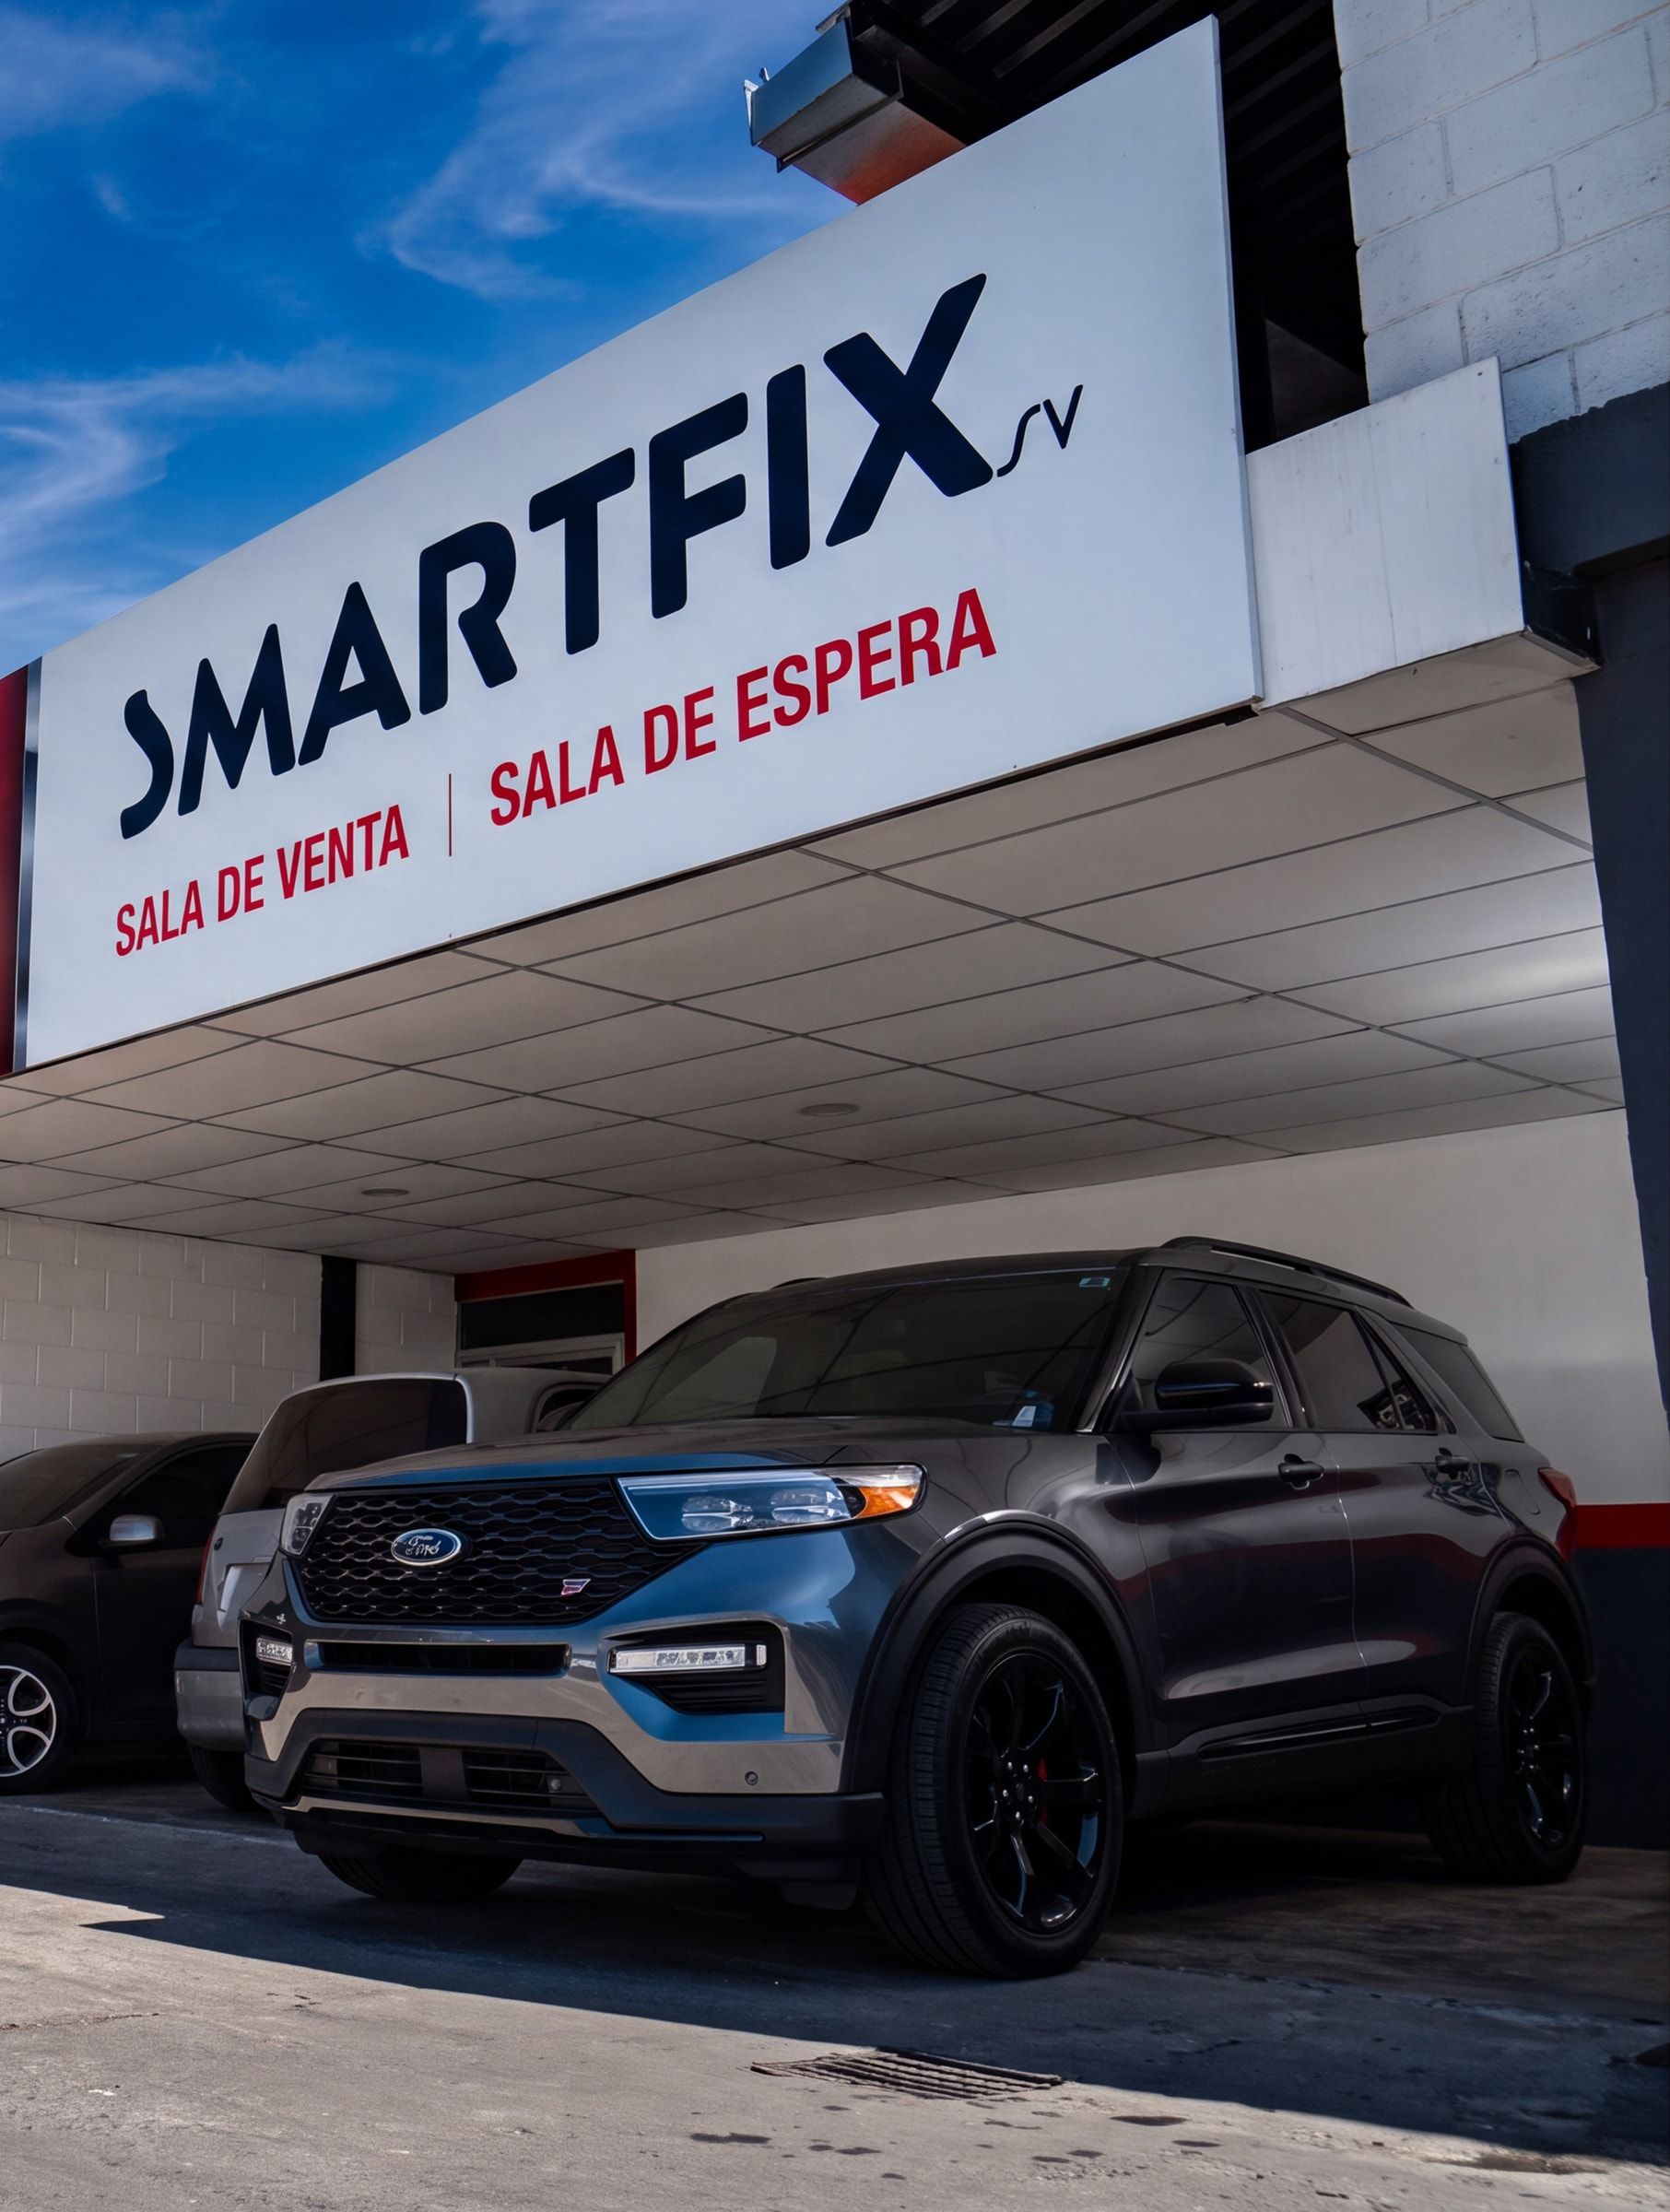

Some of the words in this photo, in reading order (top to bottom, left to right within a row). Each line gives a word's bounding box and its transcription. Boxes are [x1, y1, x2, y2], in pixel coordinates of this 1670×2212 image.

[120, 273, 994, 839] SMARTFIX
[489, 724, 626, 827] SALA
[642, 686, 717, 775] DE
[736, 588, 997, 743] ESPERA
[115, 879, 205, 957] SALA
[217, 854, 265, 923] DE
[276, 804, 410, 900] VENTA
[406, 1535, 441, 1557] Ford
